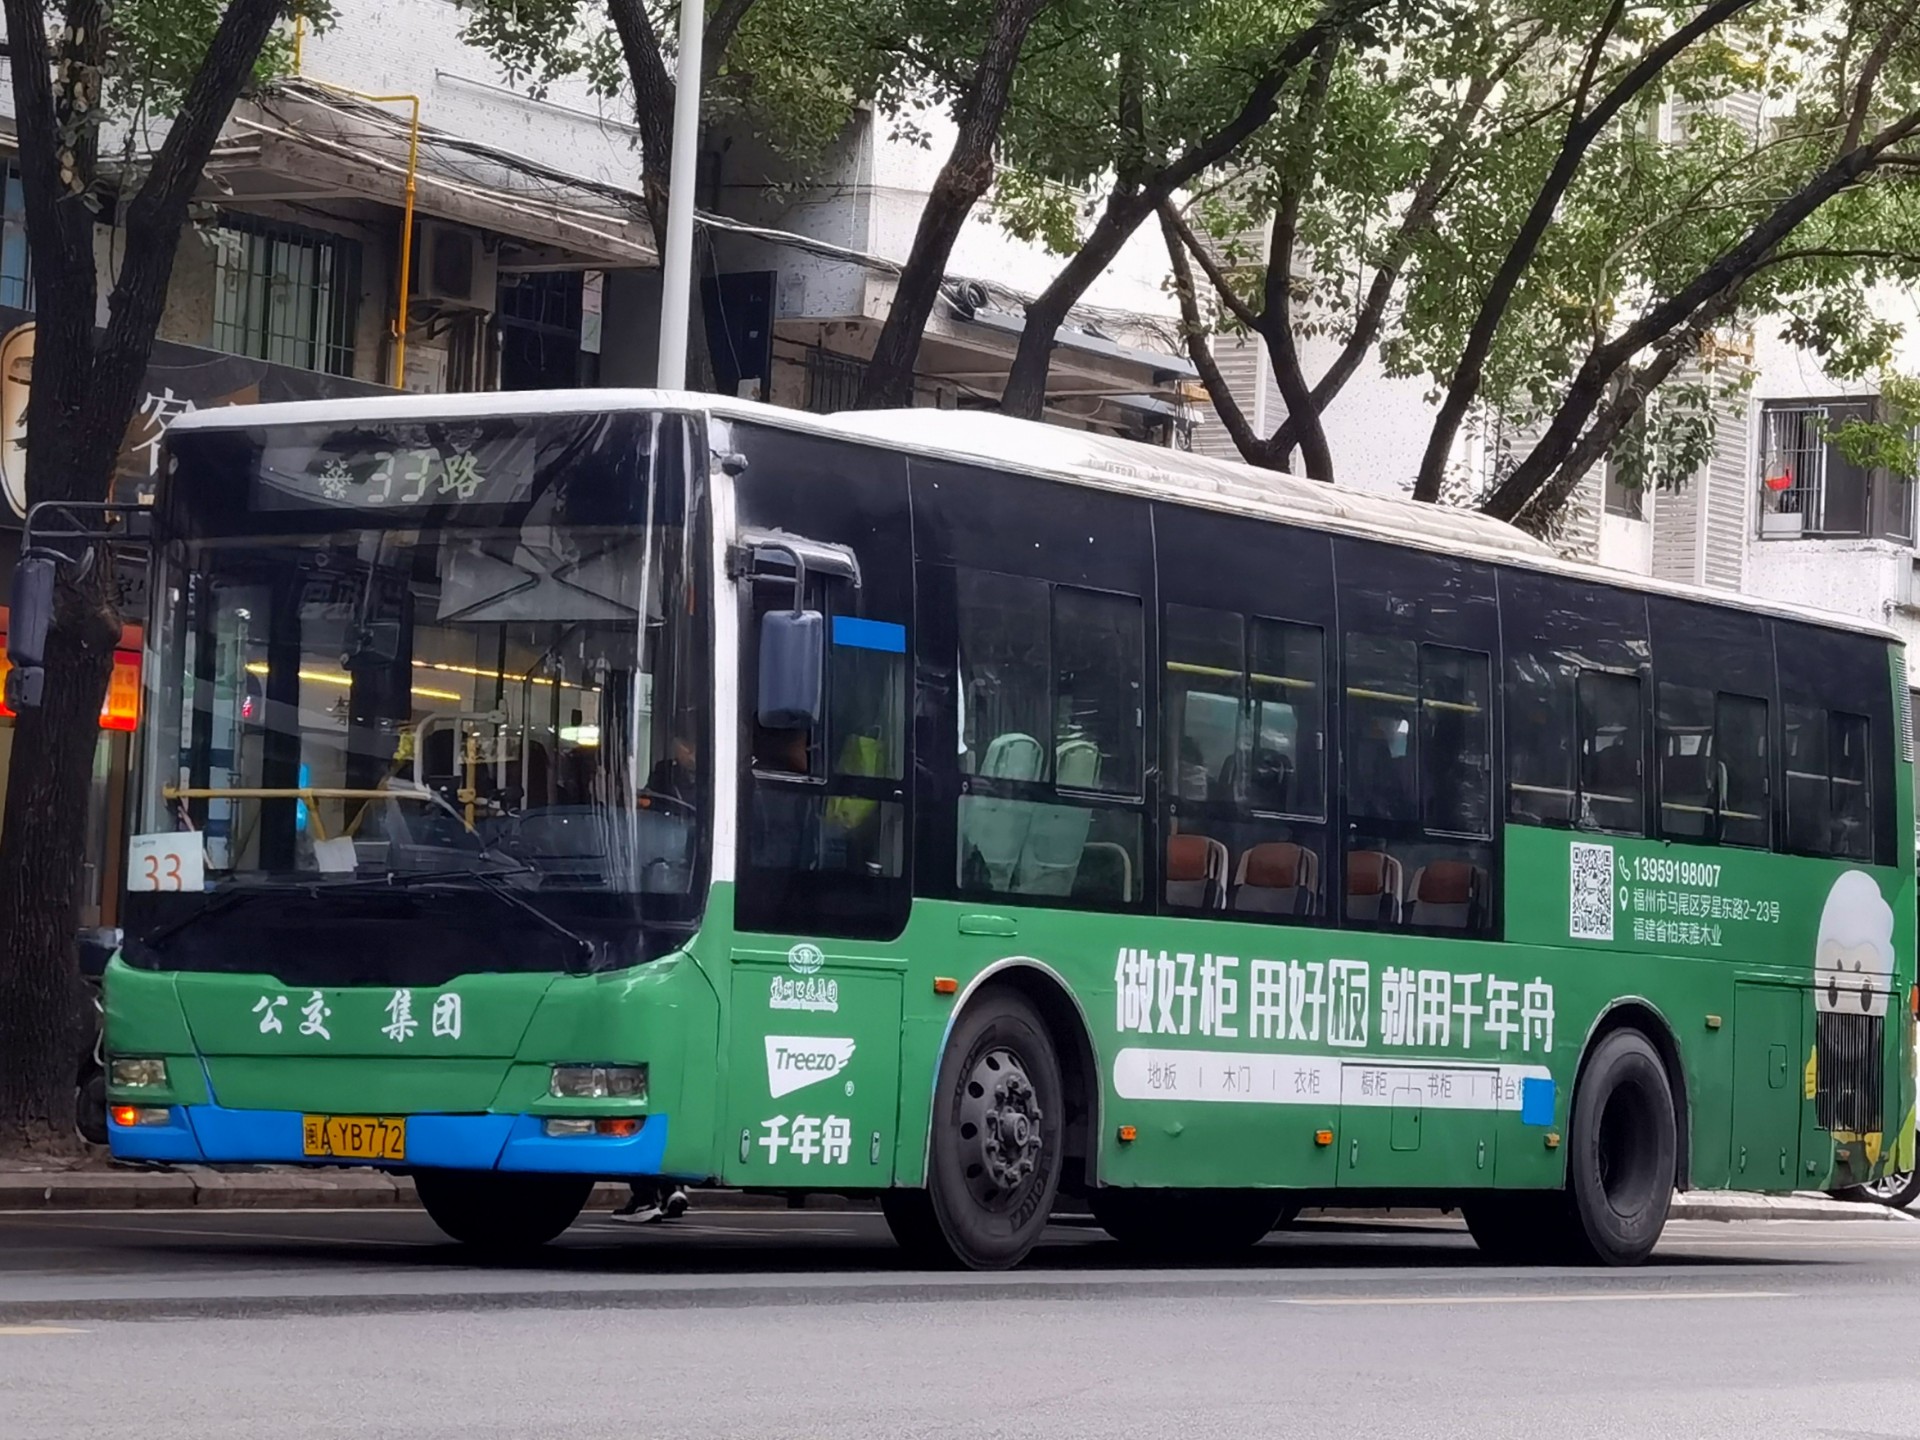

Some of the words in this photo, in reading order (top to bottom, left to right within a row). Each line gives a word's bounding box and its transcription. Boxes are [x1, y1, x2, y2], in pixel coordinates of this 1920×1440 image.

[367, 451, 486, 503] 33路
[144, 853, 182, 891] 33
[1633, 856, 1722, 888] 13959198007
[1633, 887, 1781, 924] 福州市马尾区罗星东路2-23号
[252, 991, 332, 1041] 公交
[381, 988, 461, 1043] 集团
[1114, 947, 1240, 1038] 做好柜
[1250, 958, 1370, 1048] 用好板
[1380, 965, 1556, 1053] 就用千年舟
[775, 1047, 838, 1072] Treezo
[1147, 1061, 1178, 1091] 地板
[1222, 1065, 1251, 1093] 木门
[1293, 1067, 1321, 1095] 衣柜
[1360, 1070, 1388, 1098] 橱柜
[1427, 1073, 1453, 1099] 书柜
[758, 1114, 852, 1165] 千年舟
